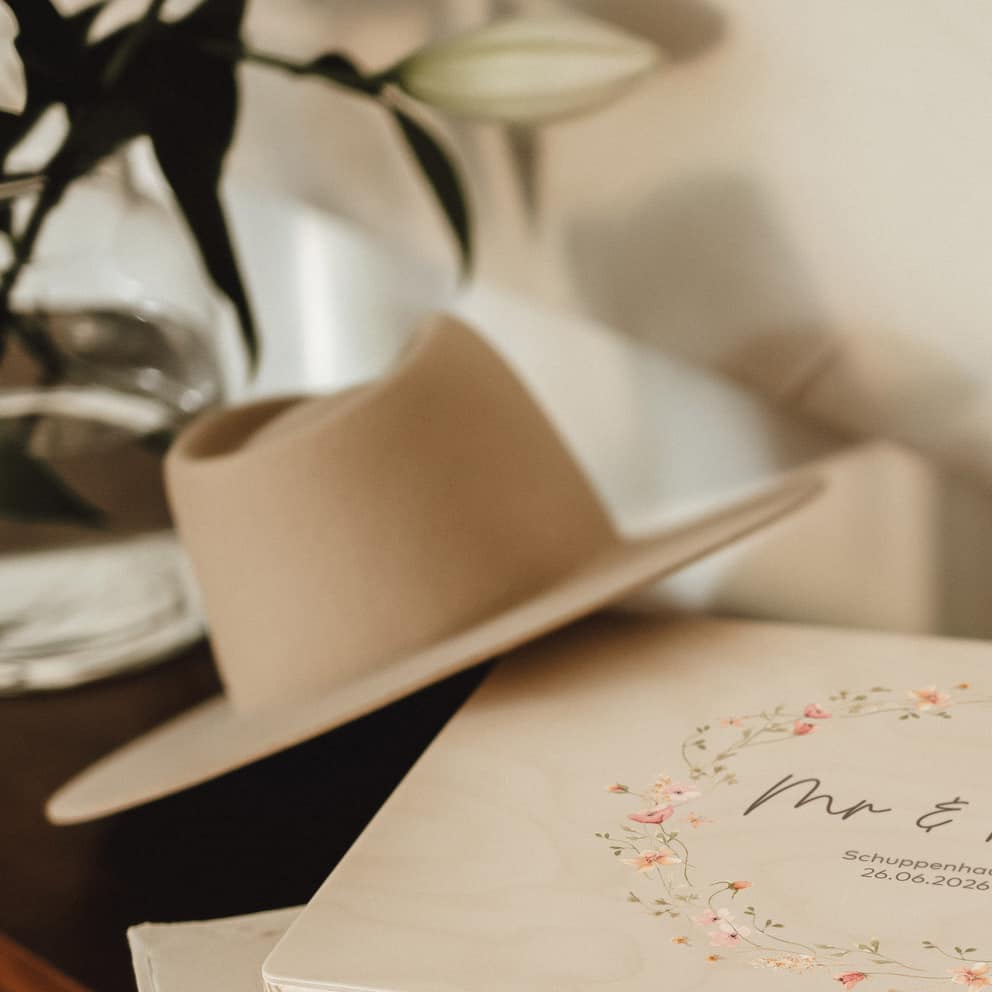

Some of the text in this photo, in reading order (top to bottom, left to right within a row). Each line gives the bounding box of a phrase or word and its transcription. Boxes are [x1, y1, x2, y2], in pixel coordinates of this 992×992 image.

[743, 773, 892, 821] Mr
[915, 796, 970, 833] &
[860, 867, 990, 892] 26.06.2026
